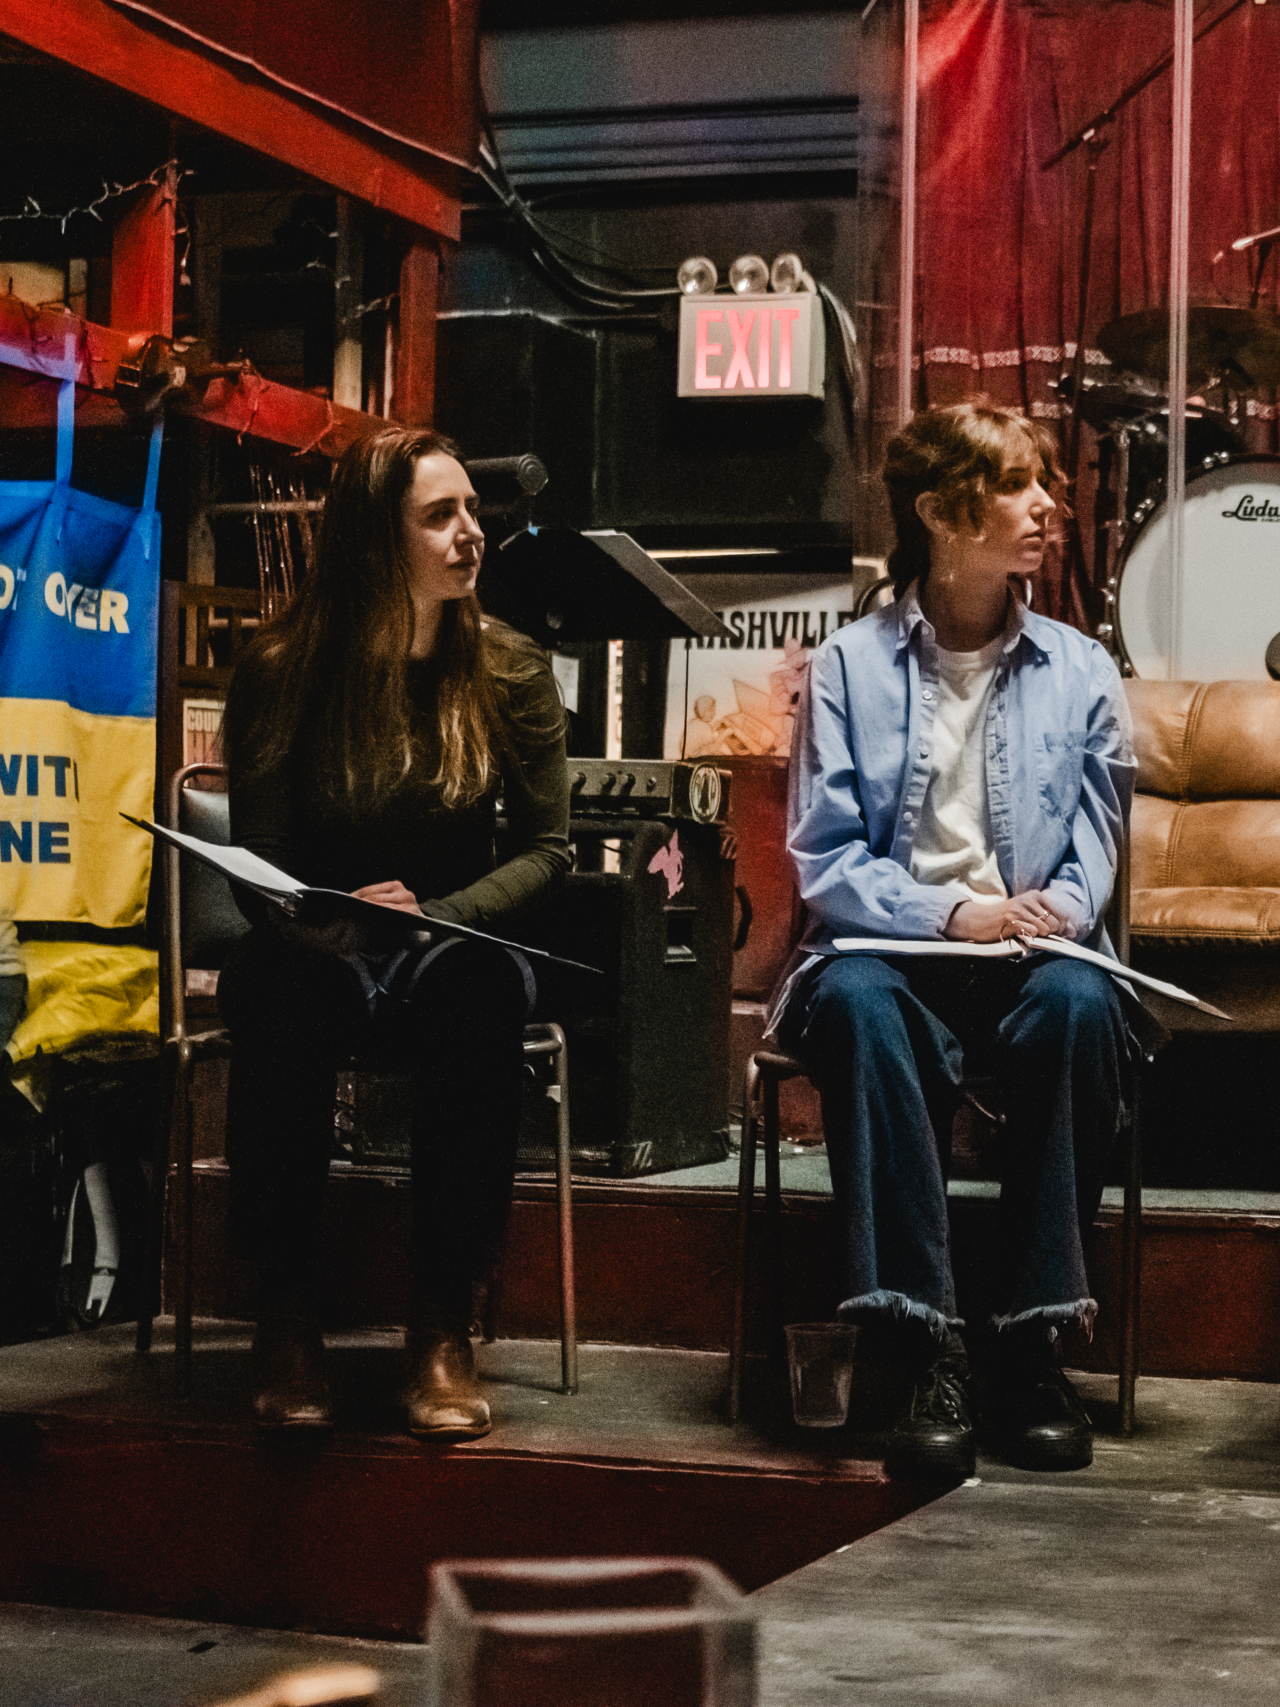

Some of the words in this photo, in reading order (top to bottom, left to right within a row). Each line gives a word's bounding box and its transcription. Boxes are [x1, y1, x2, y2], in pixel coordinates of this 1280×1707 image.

[695, 308, 800, 390] EXIT
[44, 570, 130, 634] OVER
[684, 611, 855, 649] SHVILL
[0, 820, 71, 864] NE
